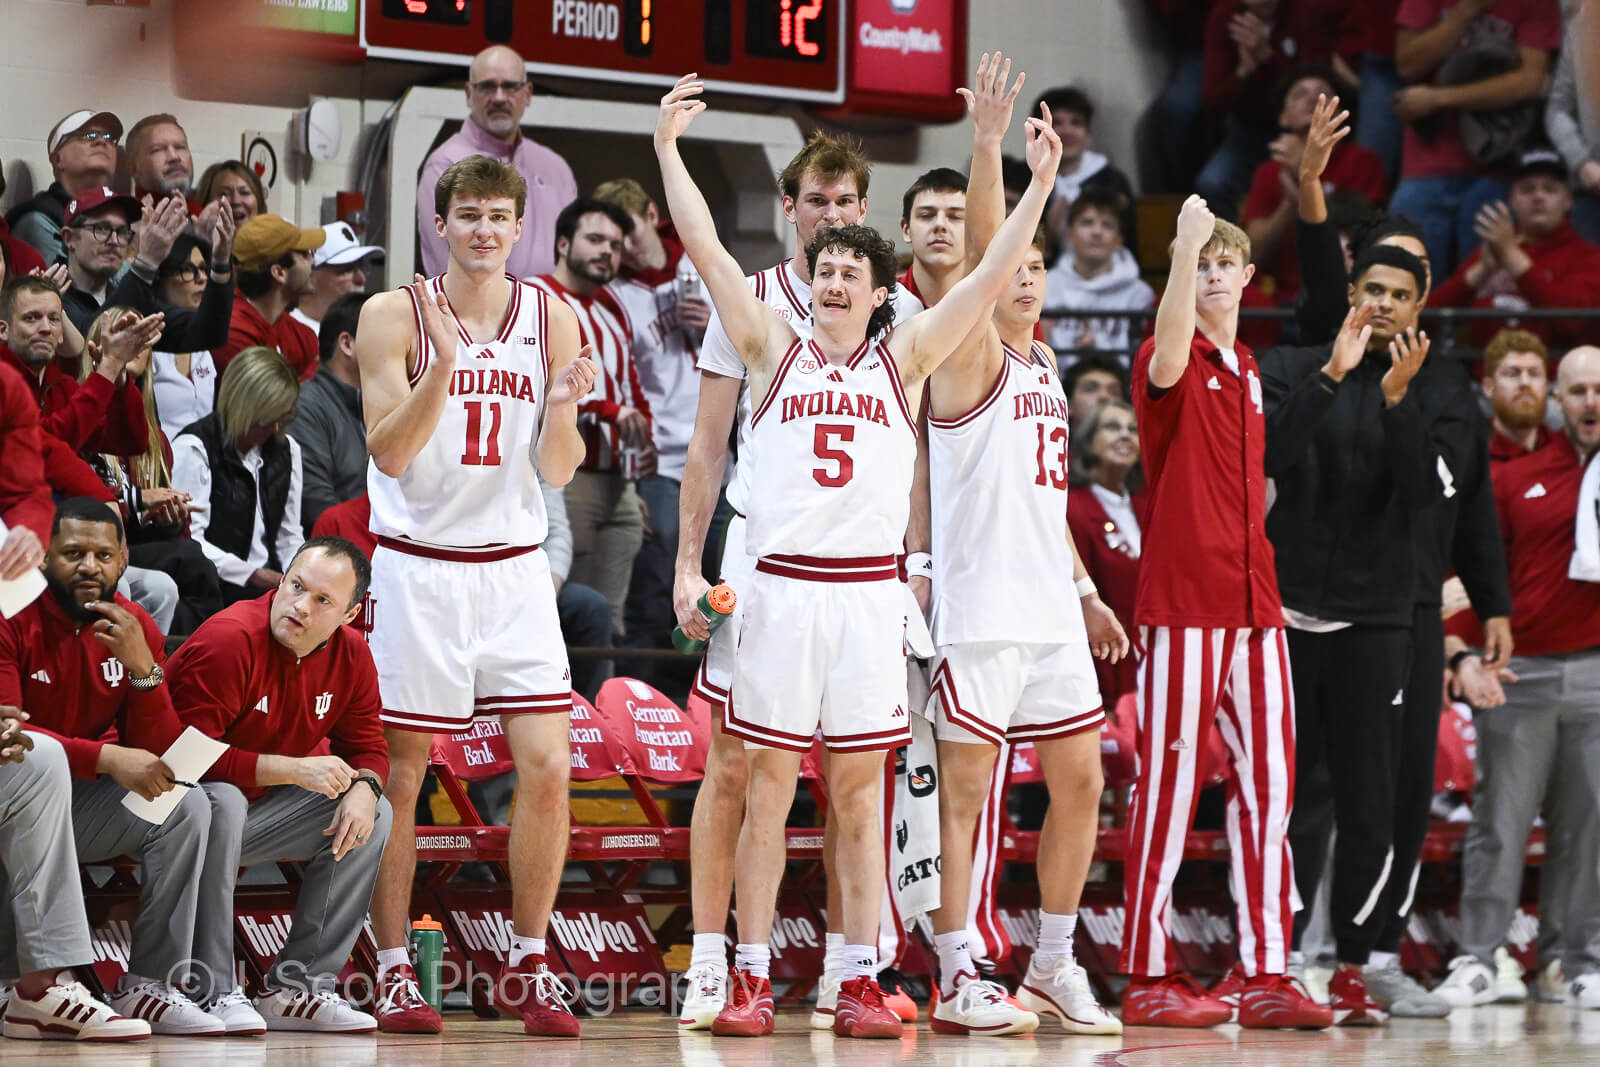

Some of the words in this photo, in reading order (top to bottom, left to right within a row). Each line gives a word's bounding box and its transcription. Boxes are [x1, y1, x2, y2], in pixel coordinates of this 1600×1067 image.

[551, 1, 619, 41] PERIOD
[860, 21, 942, 55] CountryMark
[449, 369, 535, 404] DIANA
[781, 390, 891, 428] INDIANA
[1013, 391, 1069, 425] INDIAN
[460, 401, 502, 466] 11
[812, 423, 856, 488] 5
[1034, 422, 1069, 491] 13
[625, 700, 682, 723] German
[462, 740, 497, 767] Bank
[647, 747, 682, 772] Bank
[415, 835, 472, 849] UHOOSIERS.COM
